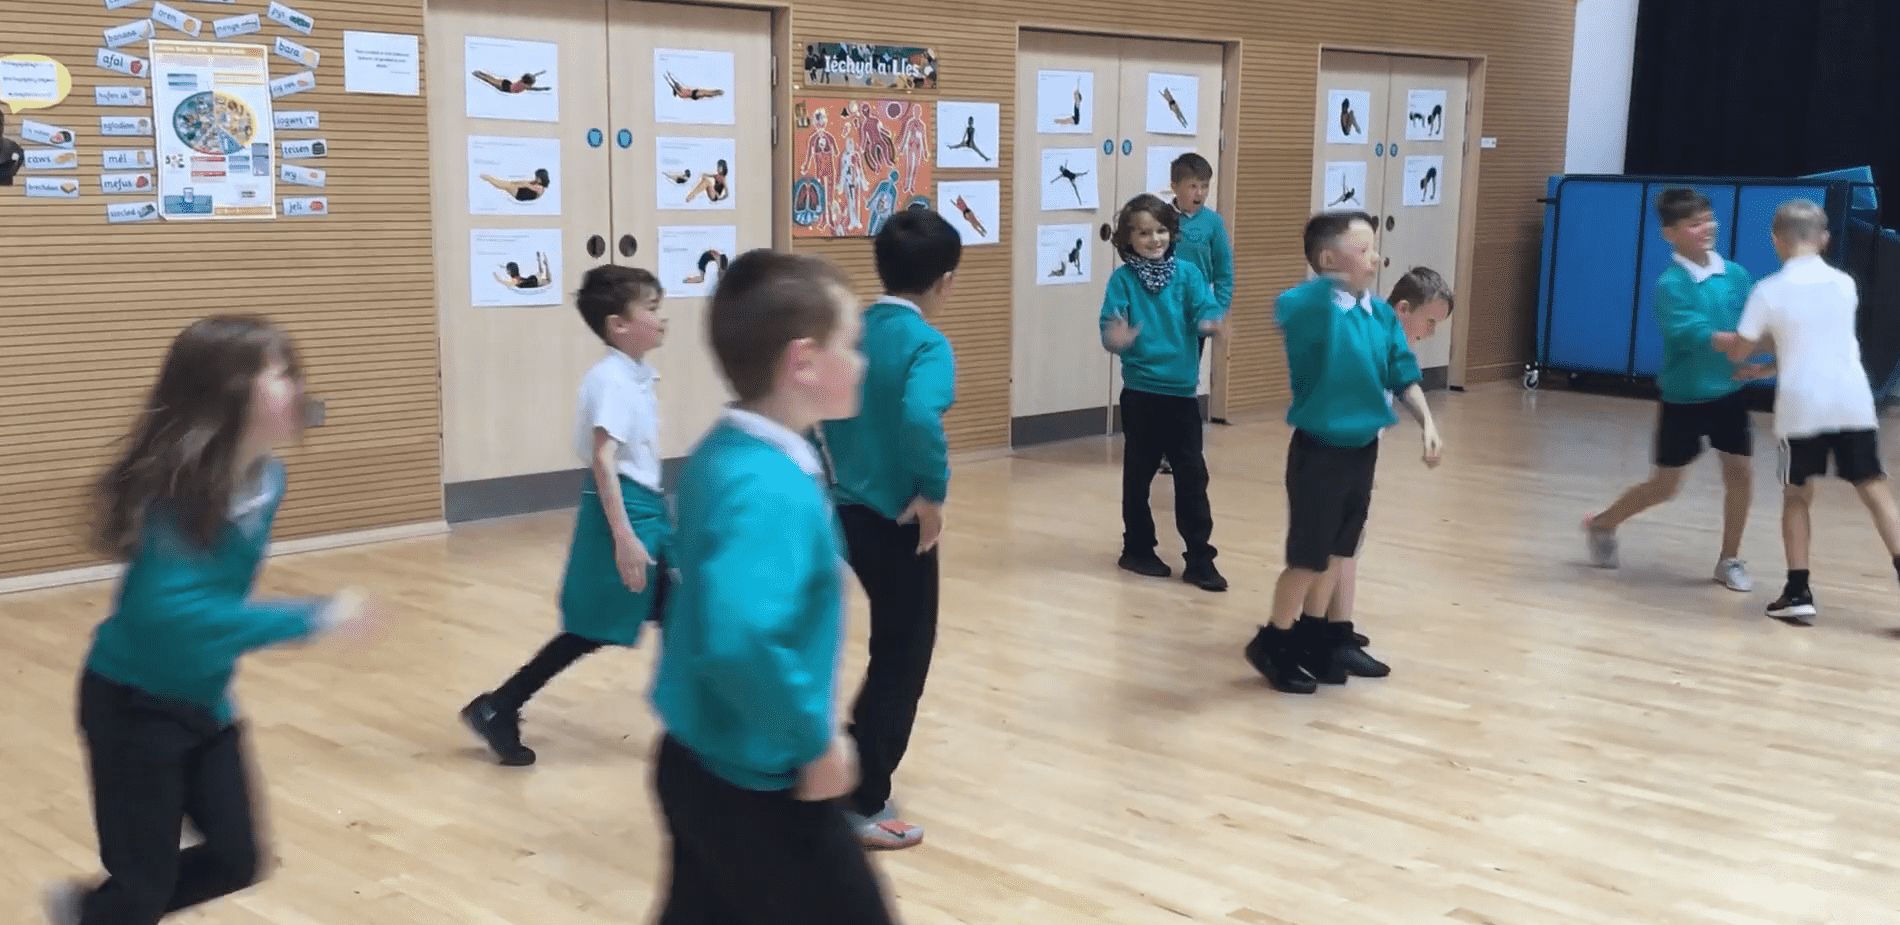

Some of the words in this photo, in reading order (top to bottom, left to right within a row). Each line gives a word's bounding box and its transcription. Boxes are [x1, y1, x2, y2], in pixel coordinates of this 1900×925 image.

[279, 41, 300, 57] bara
[102, 54, 124, 68] afal
[877, 62, 887, 75] a
[27, 156, 51, 164] caws
[103, 178, 132, 192] mefus
